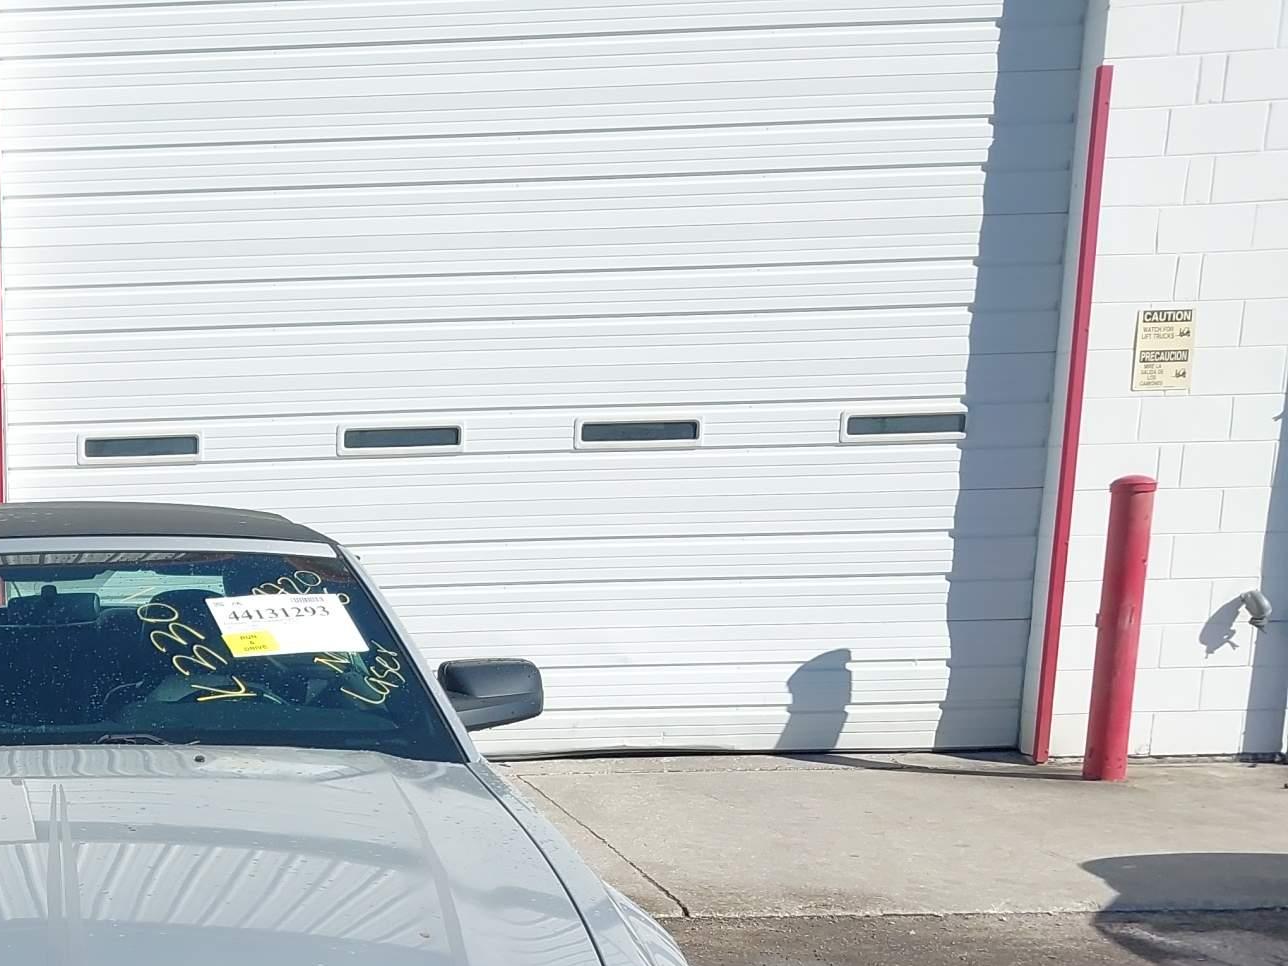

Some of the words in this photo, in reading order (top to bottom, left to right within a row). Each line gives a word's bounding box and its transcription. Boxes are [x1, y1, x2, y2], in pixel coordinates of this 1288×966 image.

[1144, 310, 1192, 322] CAUTION
[1140, 350, 1188, 361] PRECAUCION
[228, 605, 330, 621] 44131293
